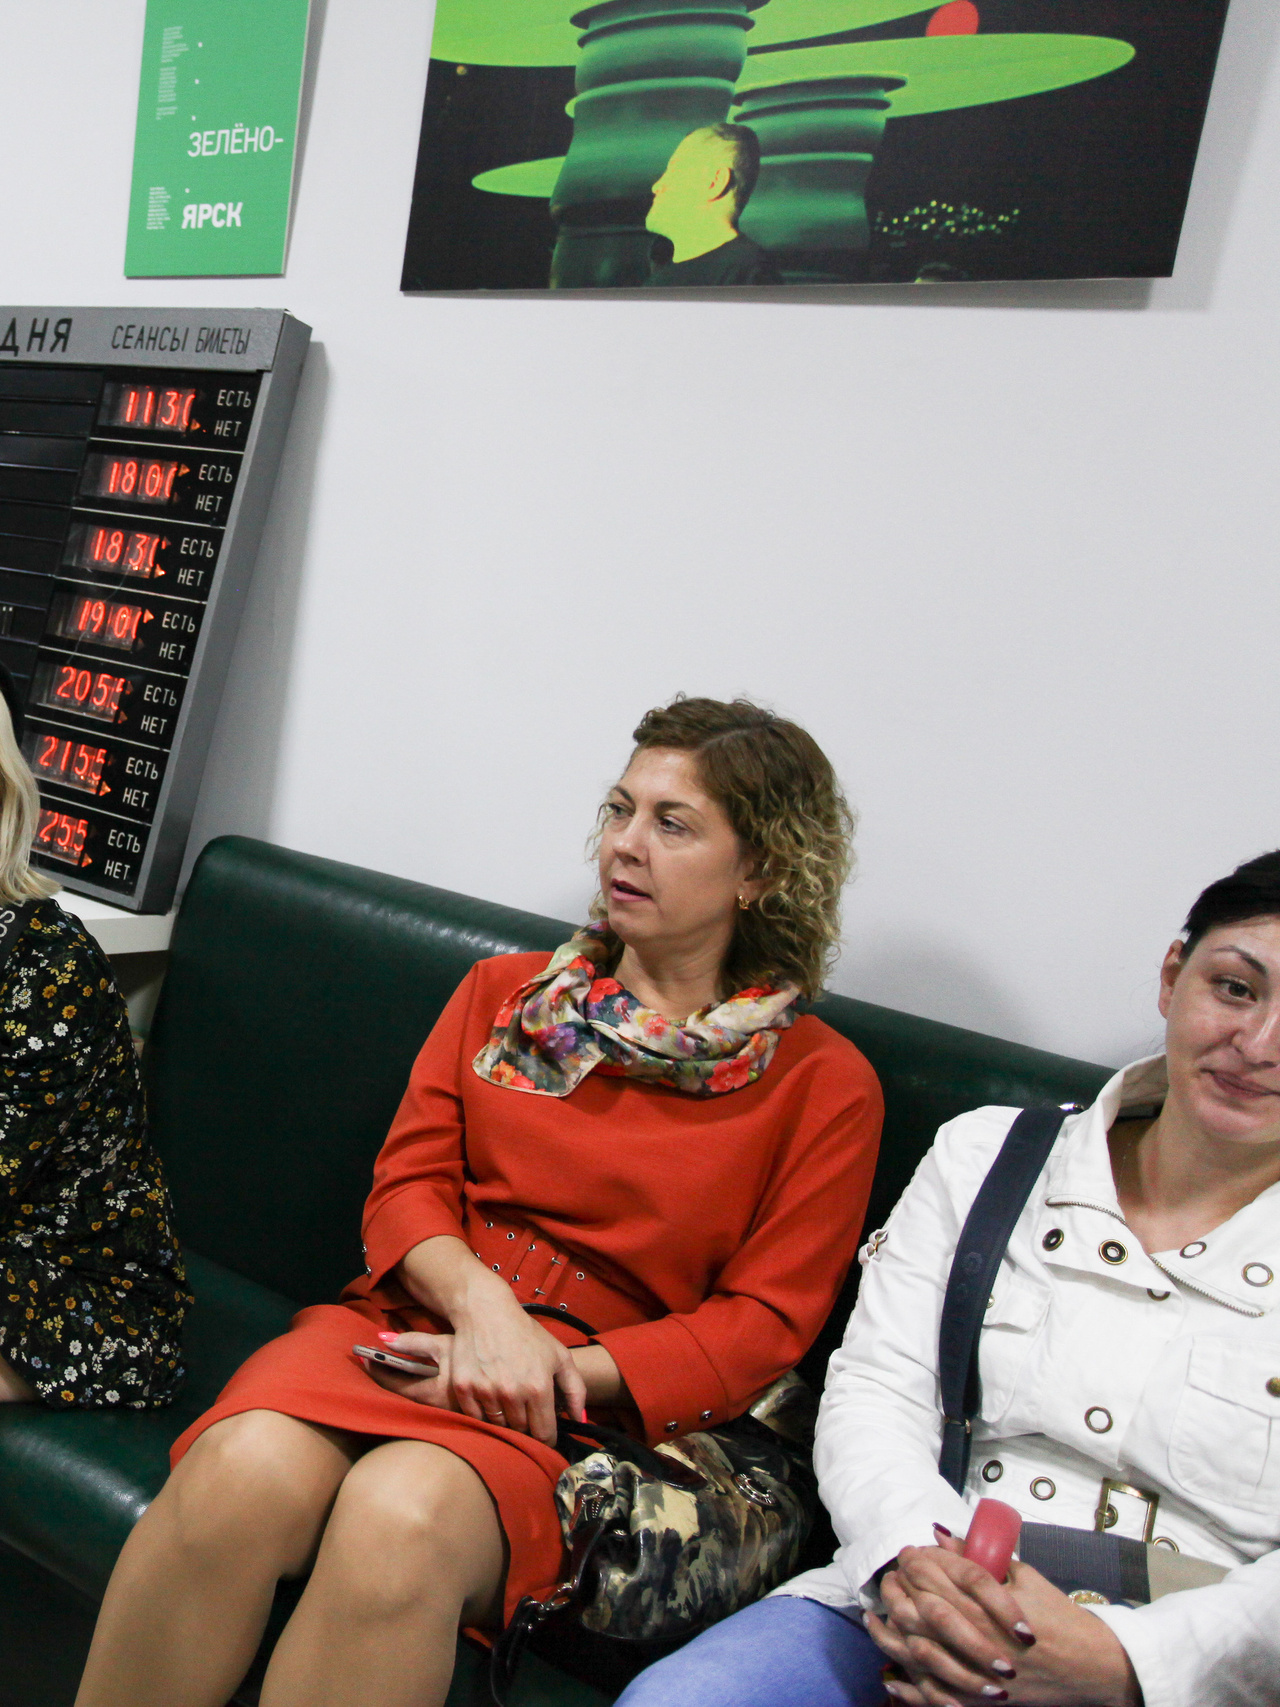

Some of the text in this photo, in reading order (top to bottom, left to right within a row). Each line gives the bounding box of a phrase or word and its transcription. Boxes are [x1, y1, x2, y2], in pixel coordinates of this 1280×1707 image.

[187, 123, 284, 157] ЗЕЛЁНО-
[181, 202, 244, 229] ЯРСК
[111, 325, 190, 352] СЕАНСЫ
[195, 327, 252, 355] БИЛЕТЫ
[216, 389, 252, 408] ЕСТЬ
[214, 420, 242, 437] НЕТ
[198, 464, 233, 483] ЕСТЬ
[195, 494, 223, 513] НЕТ
[180, 537, 214, 558] ЕСТЬ
[177, 568, 205, 587] НЕТ
[161, 611, 196, 633] ЕСТЬ
[158, 642, 186, 661] НЕТ
[143, 684, 178, 707] ЕСТЬ
[140, 715, 168, 735] НЕТ
[125, 757, 159, 780] ЕСТЬ
[122, 787, 150, 808] НЕТ
[107, 829, 141, 853] ЕСТЬ
[104, 859, 131, 881] НЕТ
